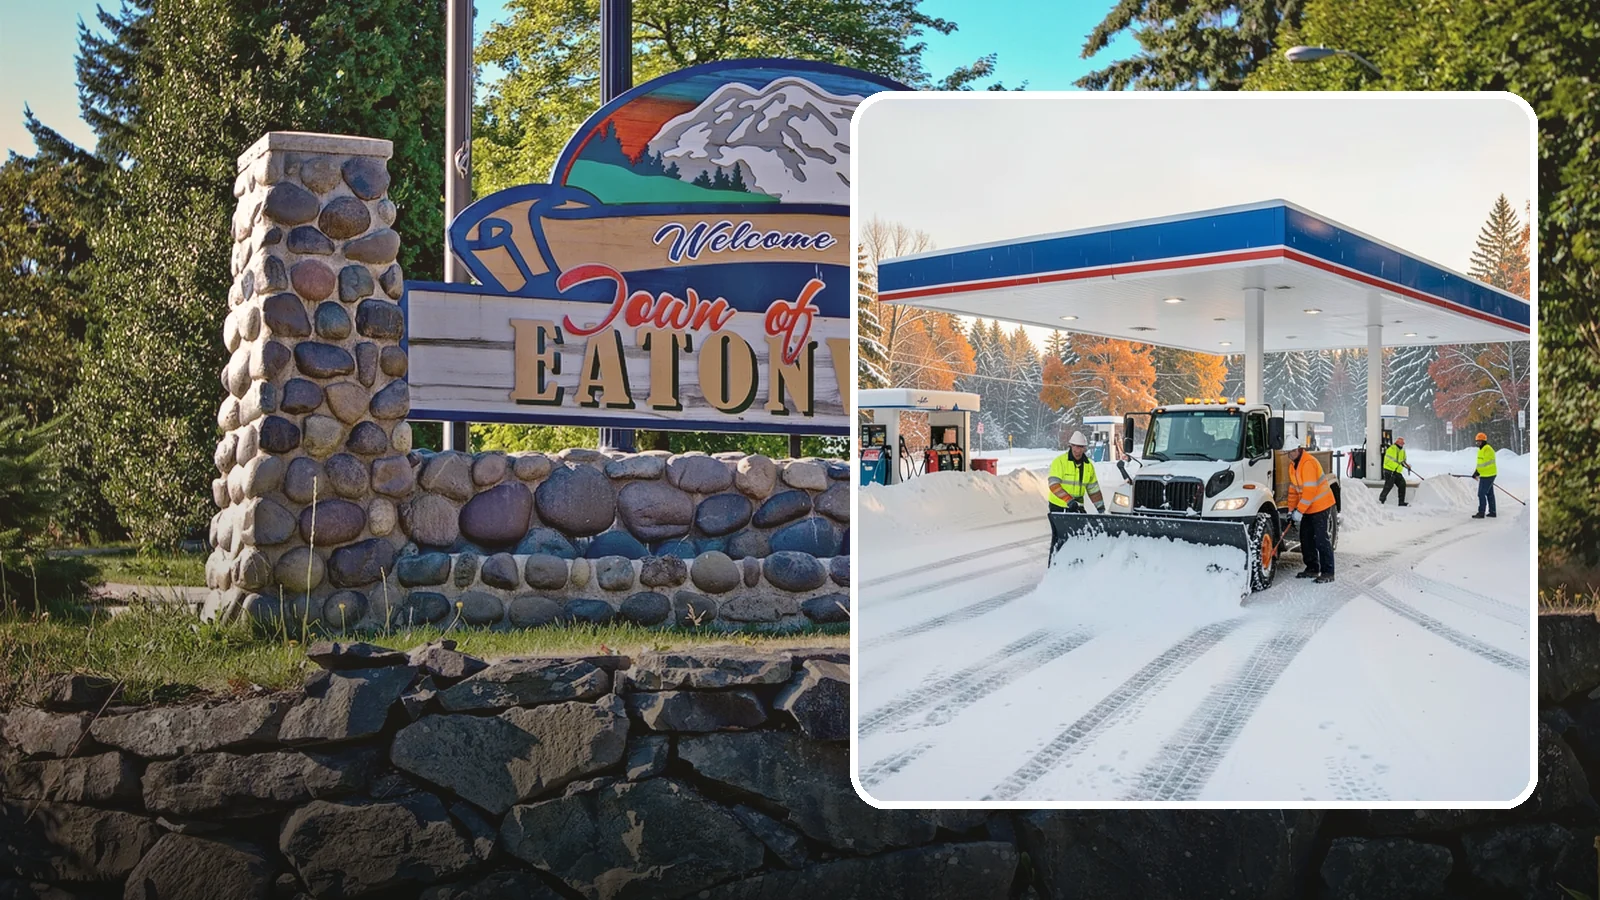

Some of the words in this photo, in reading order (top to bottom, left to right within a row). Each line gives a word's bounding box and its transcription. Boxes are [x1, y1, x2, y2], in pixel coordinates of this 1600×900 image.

[653, 220, 837, 264] Welcome
[556, 263, 736, 337] Town
[764, 278, 826, 366] of
